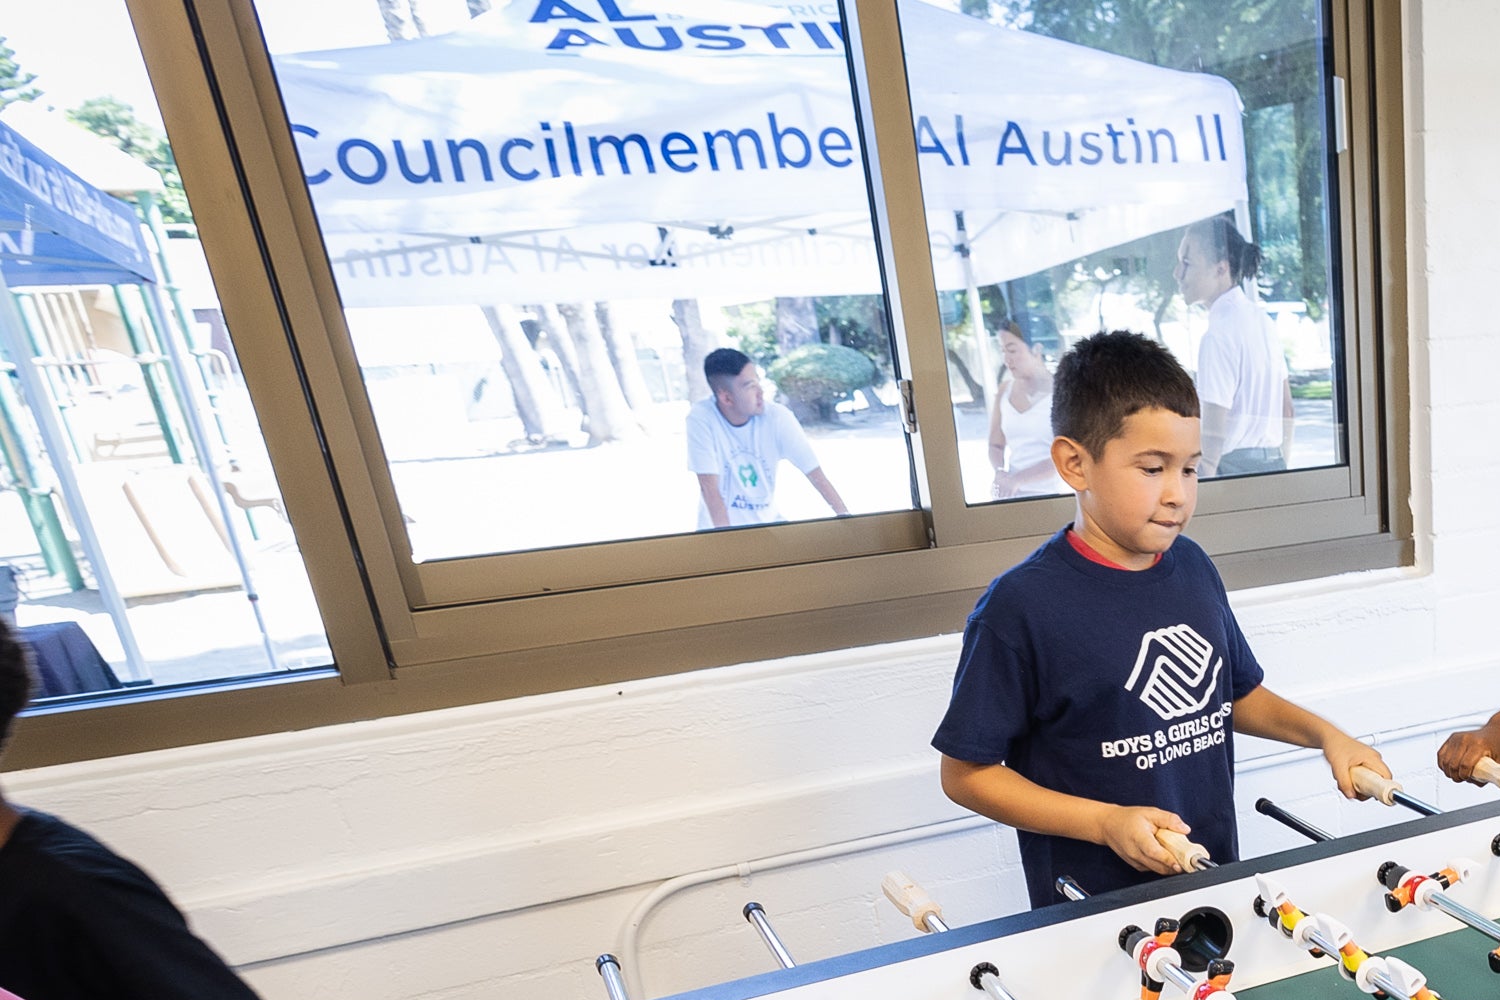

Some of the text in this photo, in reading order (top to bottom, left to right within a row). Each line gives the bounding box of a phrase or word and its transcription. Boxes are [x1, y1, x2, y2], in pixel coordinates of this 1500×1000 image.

[529, 0, 657, 23] AL
[545, 22, 844, 50] AUSTI
[291, 112, 853, 185] Councilmembe
[916, 114, 970, 166] Al
[996, 117, 1178, 166] Austin
[1101, 733, 1153, 758] BOYS
[1154, 730, 1168, 748] &
[1168, 715, 1210, 743] GIRLS
[1136, 753, 1157, 770] OF
[1159, 743, 1192, 765] LONG
